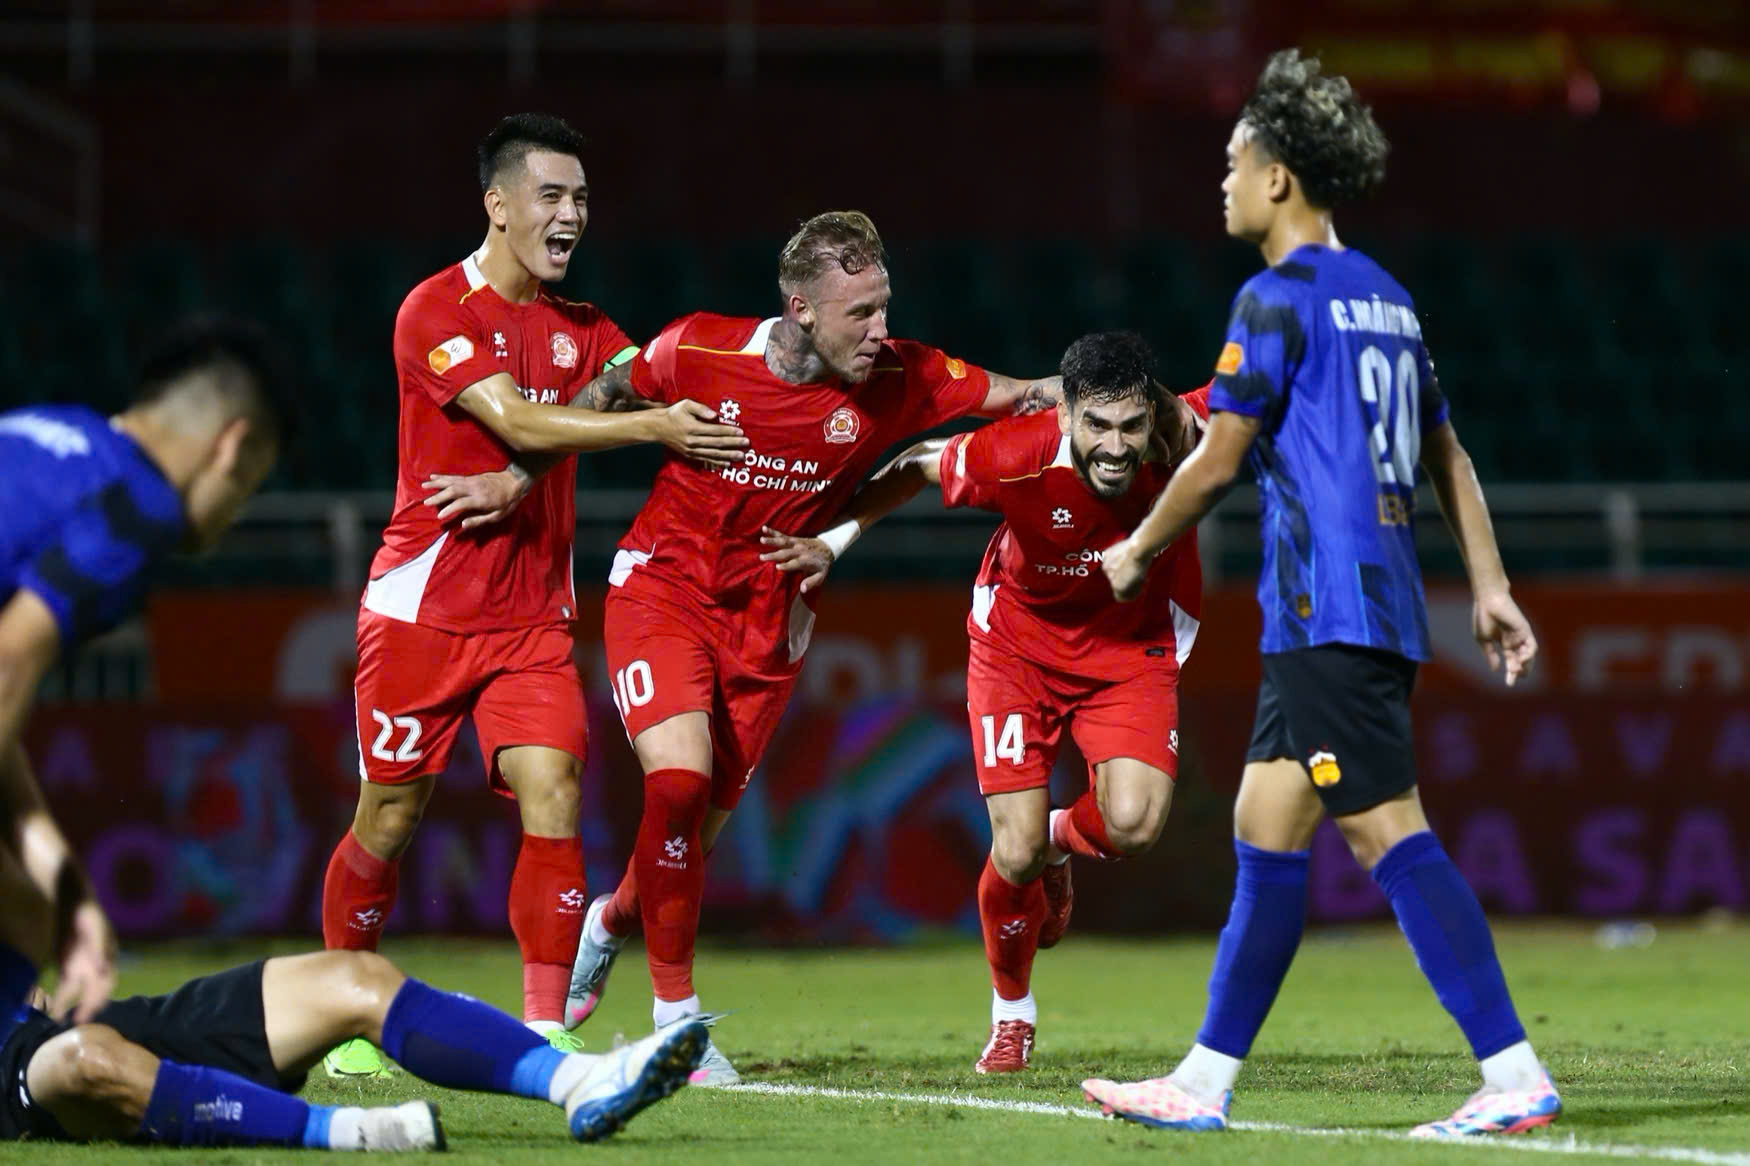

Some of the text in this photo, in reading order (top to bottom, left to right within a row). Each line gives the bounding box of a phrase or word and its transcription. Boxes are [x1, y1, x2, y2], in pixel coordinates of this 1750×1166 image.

[1359, 345, 1422, 488] 20
[744, 449, 819, 475] ÔNG AN
[753, 475, 790, 491] CHÍ
[1034, 563, 1089, 577] TP.HỒ
[1065, 548, 1106, 562] CÔN
[614, 659, 653, 719] 10
[371, 708, 422, 763] 22
[981, 713, 1026, 767] 14
